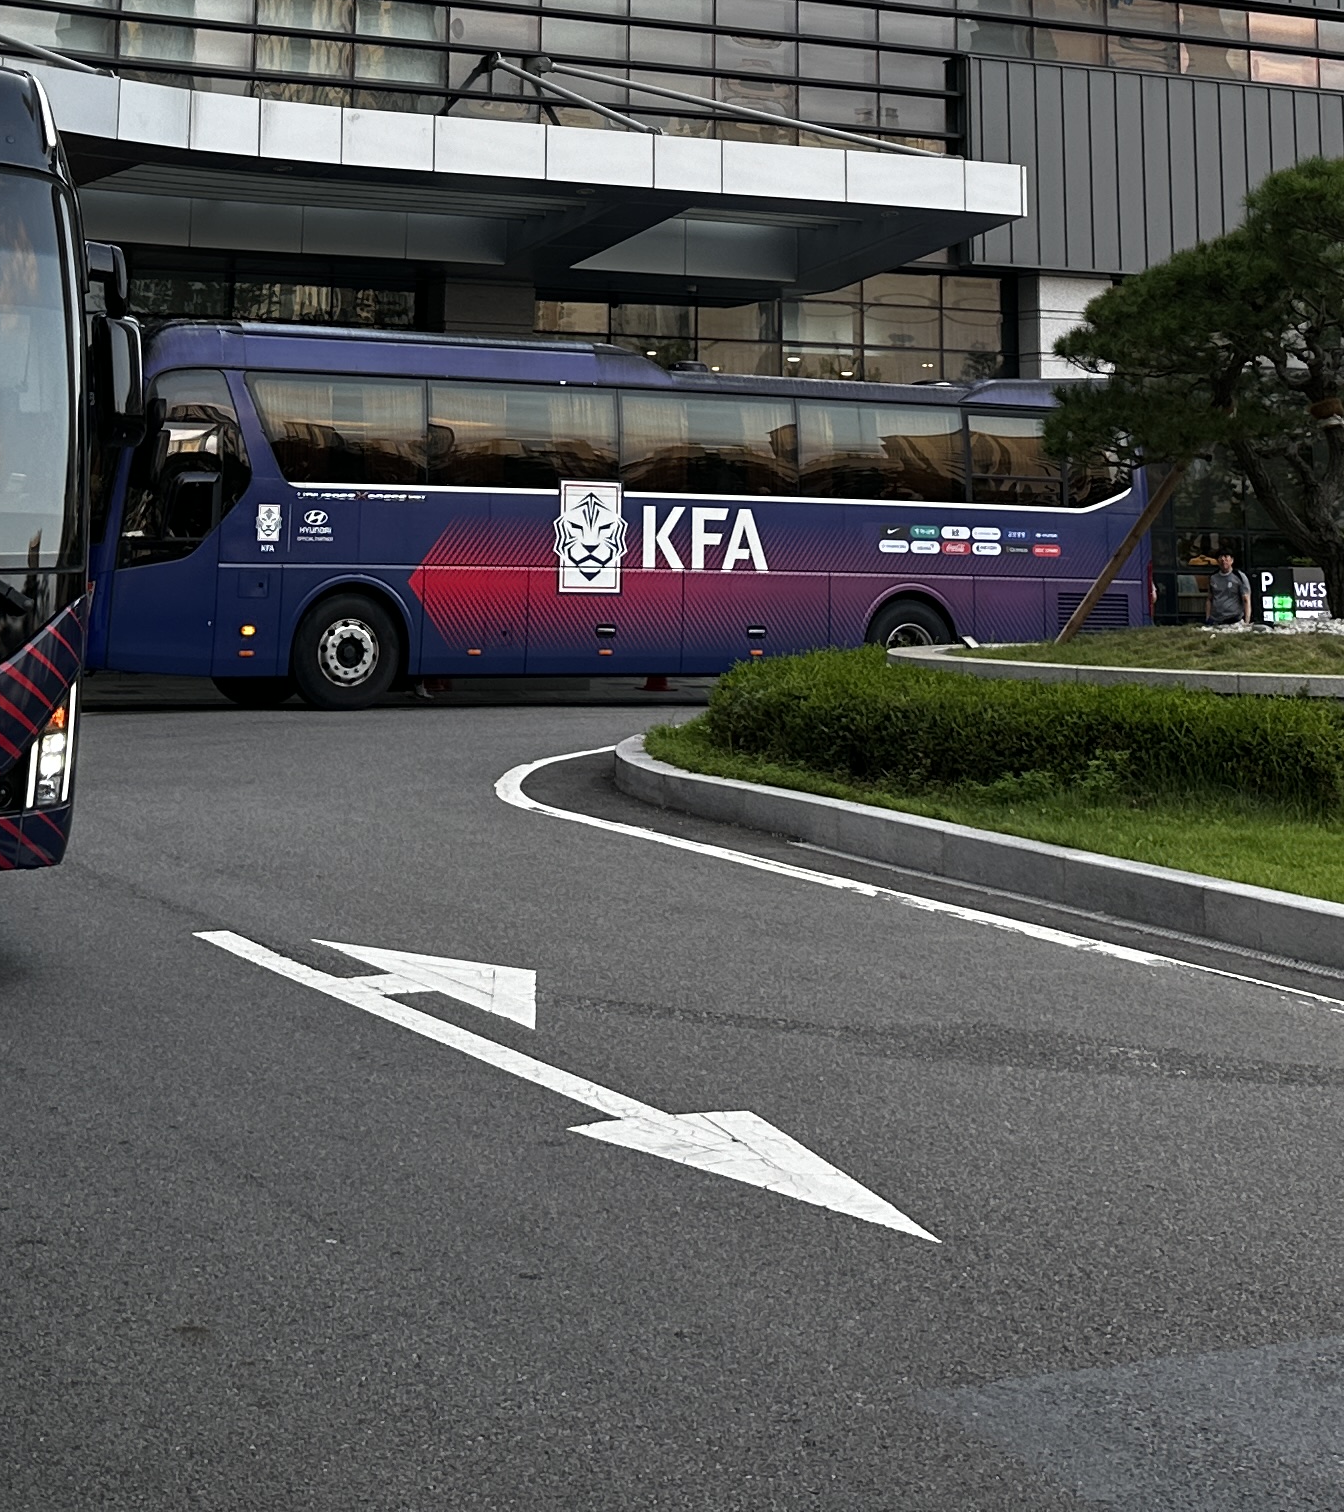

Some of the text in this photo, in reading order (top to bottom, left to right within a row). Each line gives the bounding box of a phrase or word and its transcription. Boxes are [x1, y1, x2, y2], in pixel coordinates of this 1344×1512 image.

[642, 505, 769, 573] KFA
[1261, 571, 1274, 592] P
[1293, 582, 1327, 598] WES
[1295, 599, 1323, 608] TOWER
